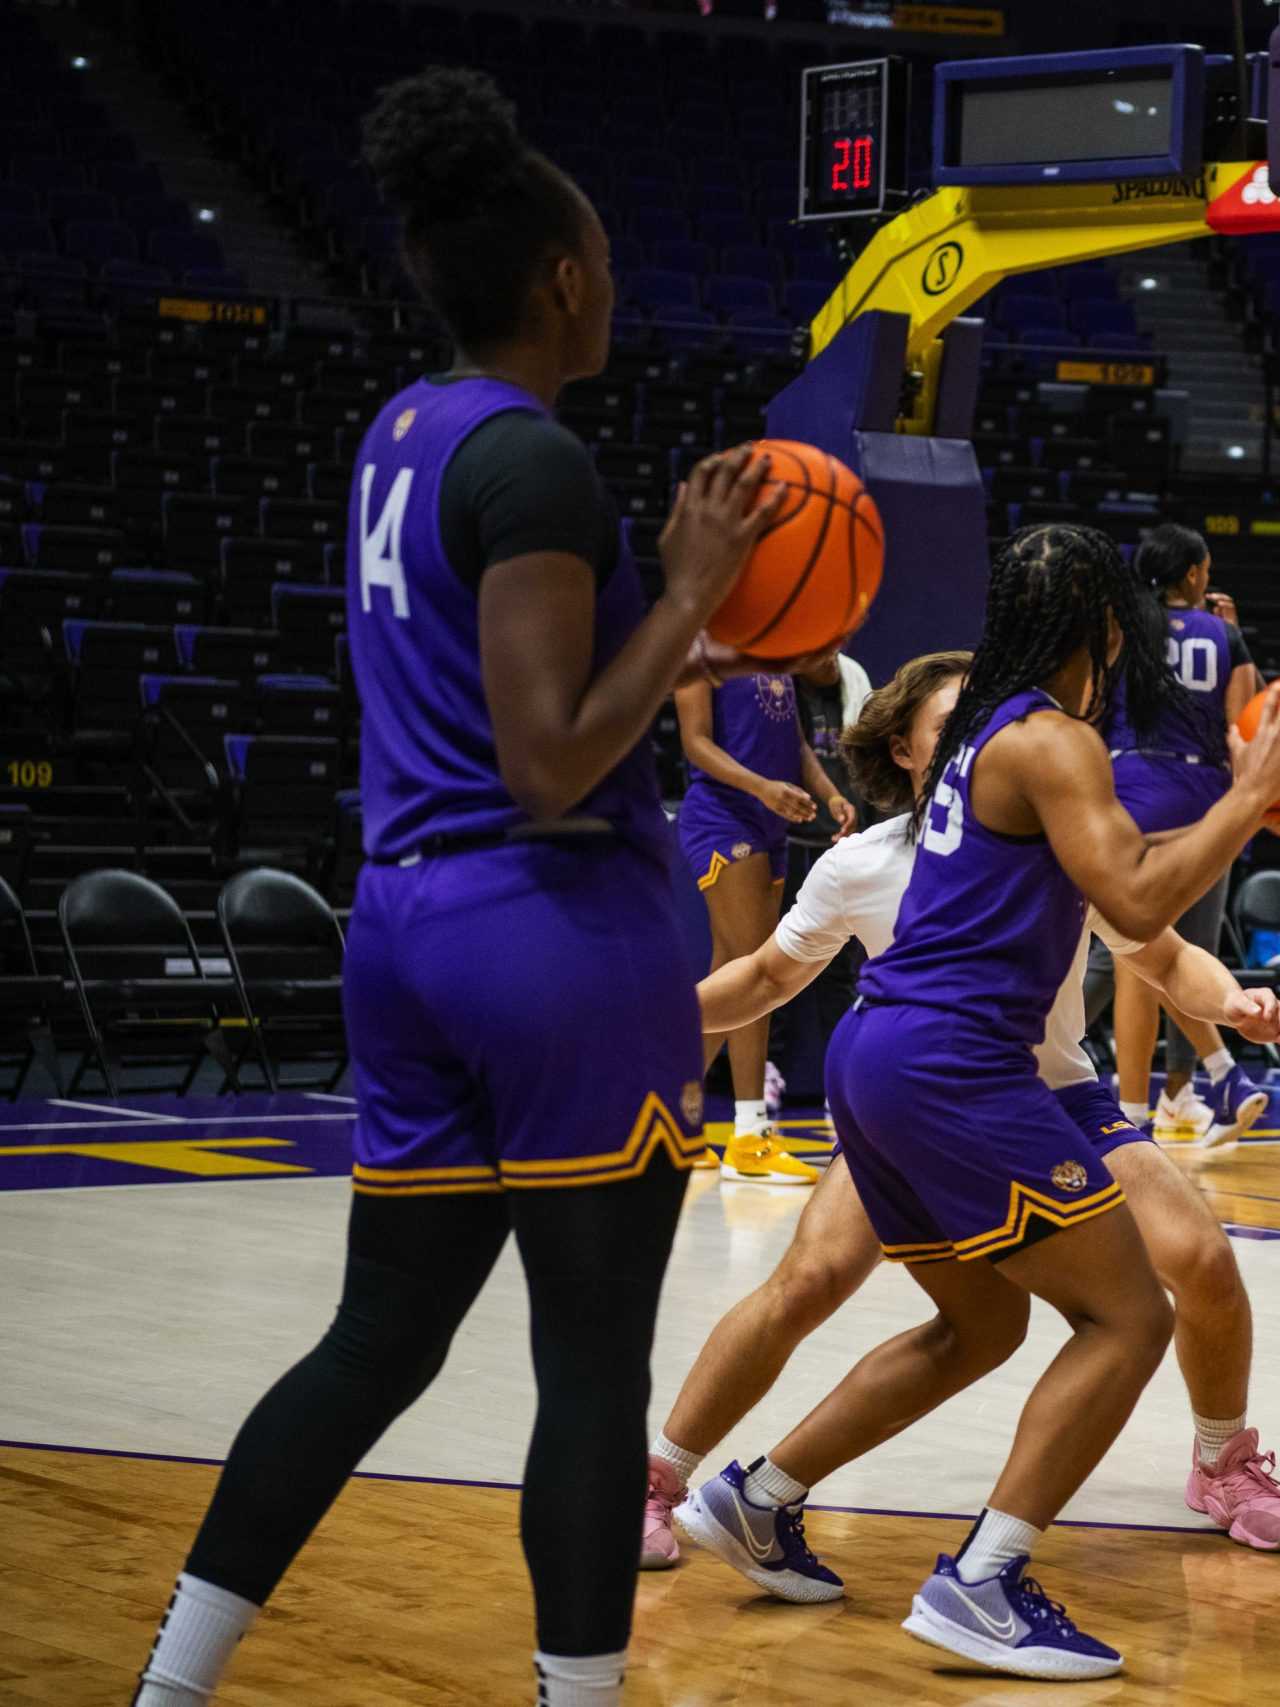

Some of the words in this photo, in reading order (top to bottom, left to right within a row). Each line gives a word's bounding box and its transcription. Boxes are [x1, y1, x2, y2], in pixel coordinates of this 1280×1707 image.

[832, 134, 872, 190] 20
[359, 463, 415, 619] 14
[8, 760, 53, 789] 109
[917, 743, 976, 856] 5
[1100, 1120, 1139, 1135] LS
